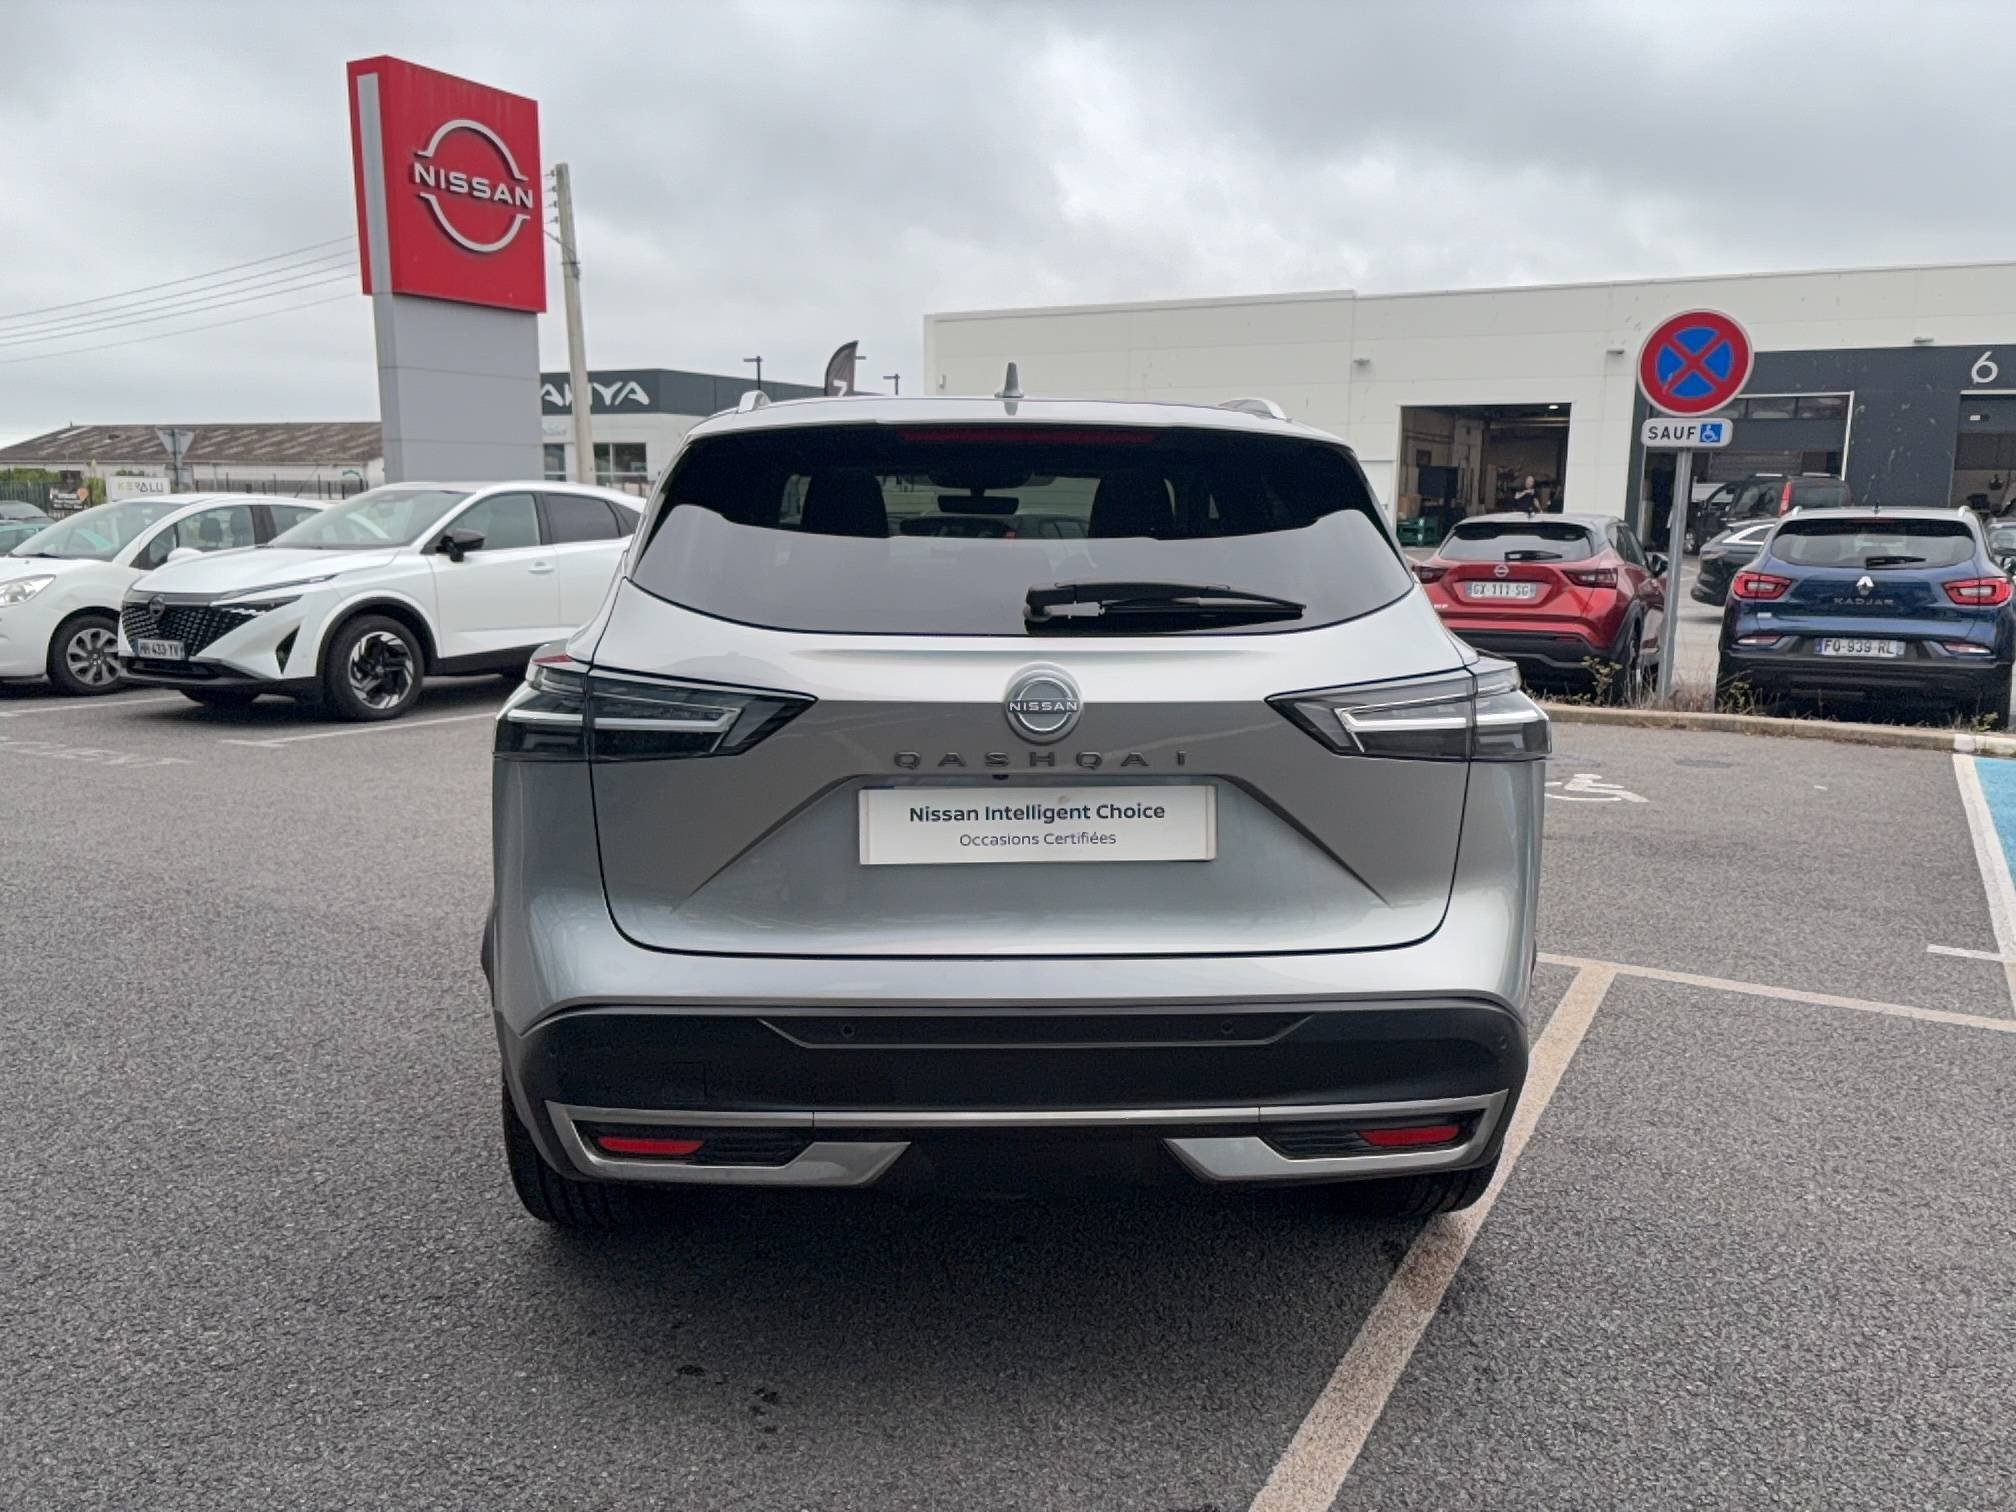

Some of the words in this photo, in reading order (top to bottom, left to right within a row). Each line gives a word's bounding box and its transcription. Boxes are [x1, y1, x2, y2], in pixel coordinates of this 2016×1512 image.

[414, 162, 533, 208] NISSAN
[1971, 351, 1999, 384] 6
[1648, 425, 1697, 441] SAUF
[1008, 700, 1079, 712] NISSAN
[894, 751, 1187, 770] QASHQAI
[909, 805, 979, 822] Nissan
[985, 804, 1091, 824] Intelligent
[1096, 803, 1166, 820] Choice
[959, 833, 1040, 847] Occasions
[1043, 831, 1117, 846] Certifiées
